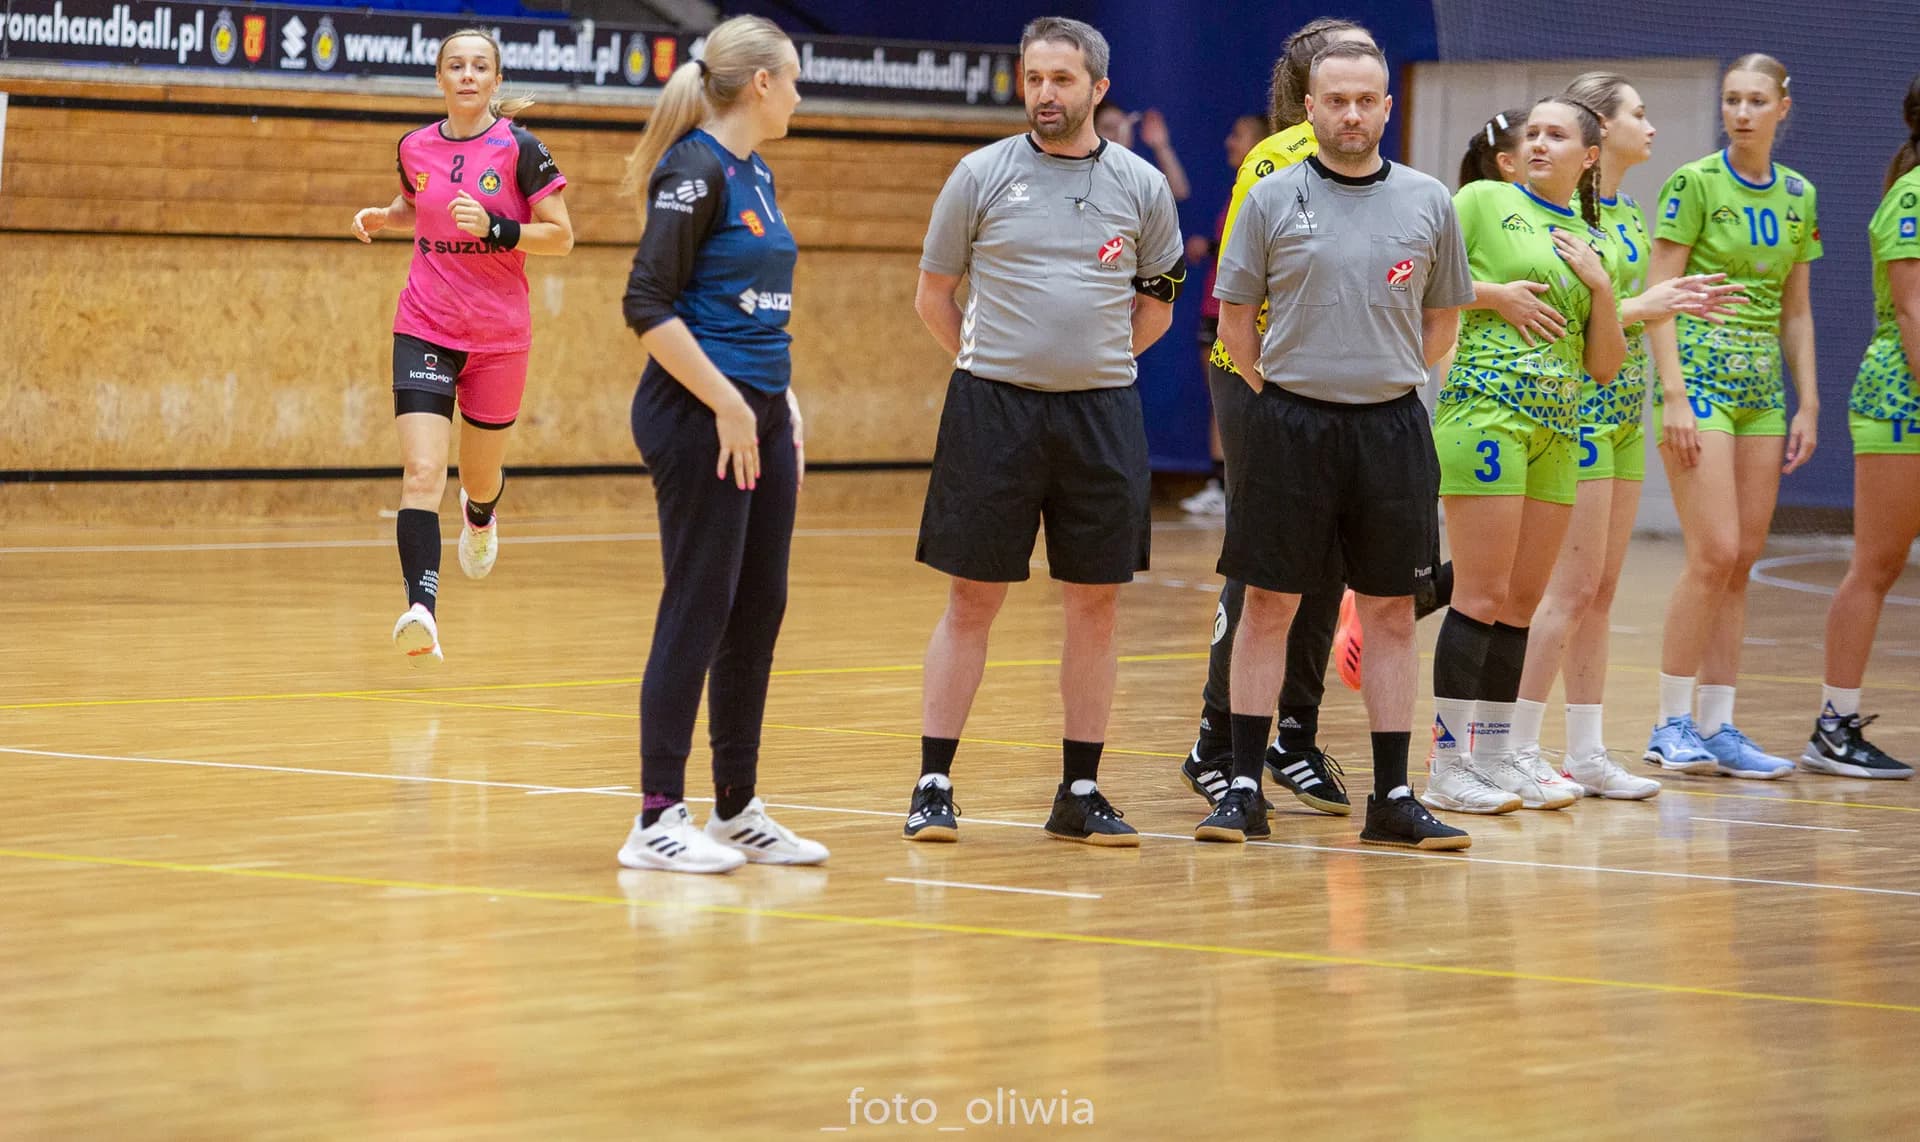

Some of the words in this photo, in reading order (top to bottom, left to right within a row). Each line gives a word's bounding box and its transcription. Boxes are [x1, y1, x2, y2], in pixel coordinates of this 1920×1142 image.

[450, 155, 464, 183] 2
[1616, 224, 1638, 262] 5
[1743, 206, 1779, 247] 10
[434, 240, 508, 254] SUZUK
[758, 291, 792, 311] SUZ
[1474, 440, 1502, 483] 3
[1578, 426, 1598, 468] 5
